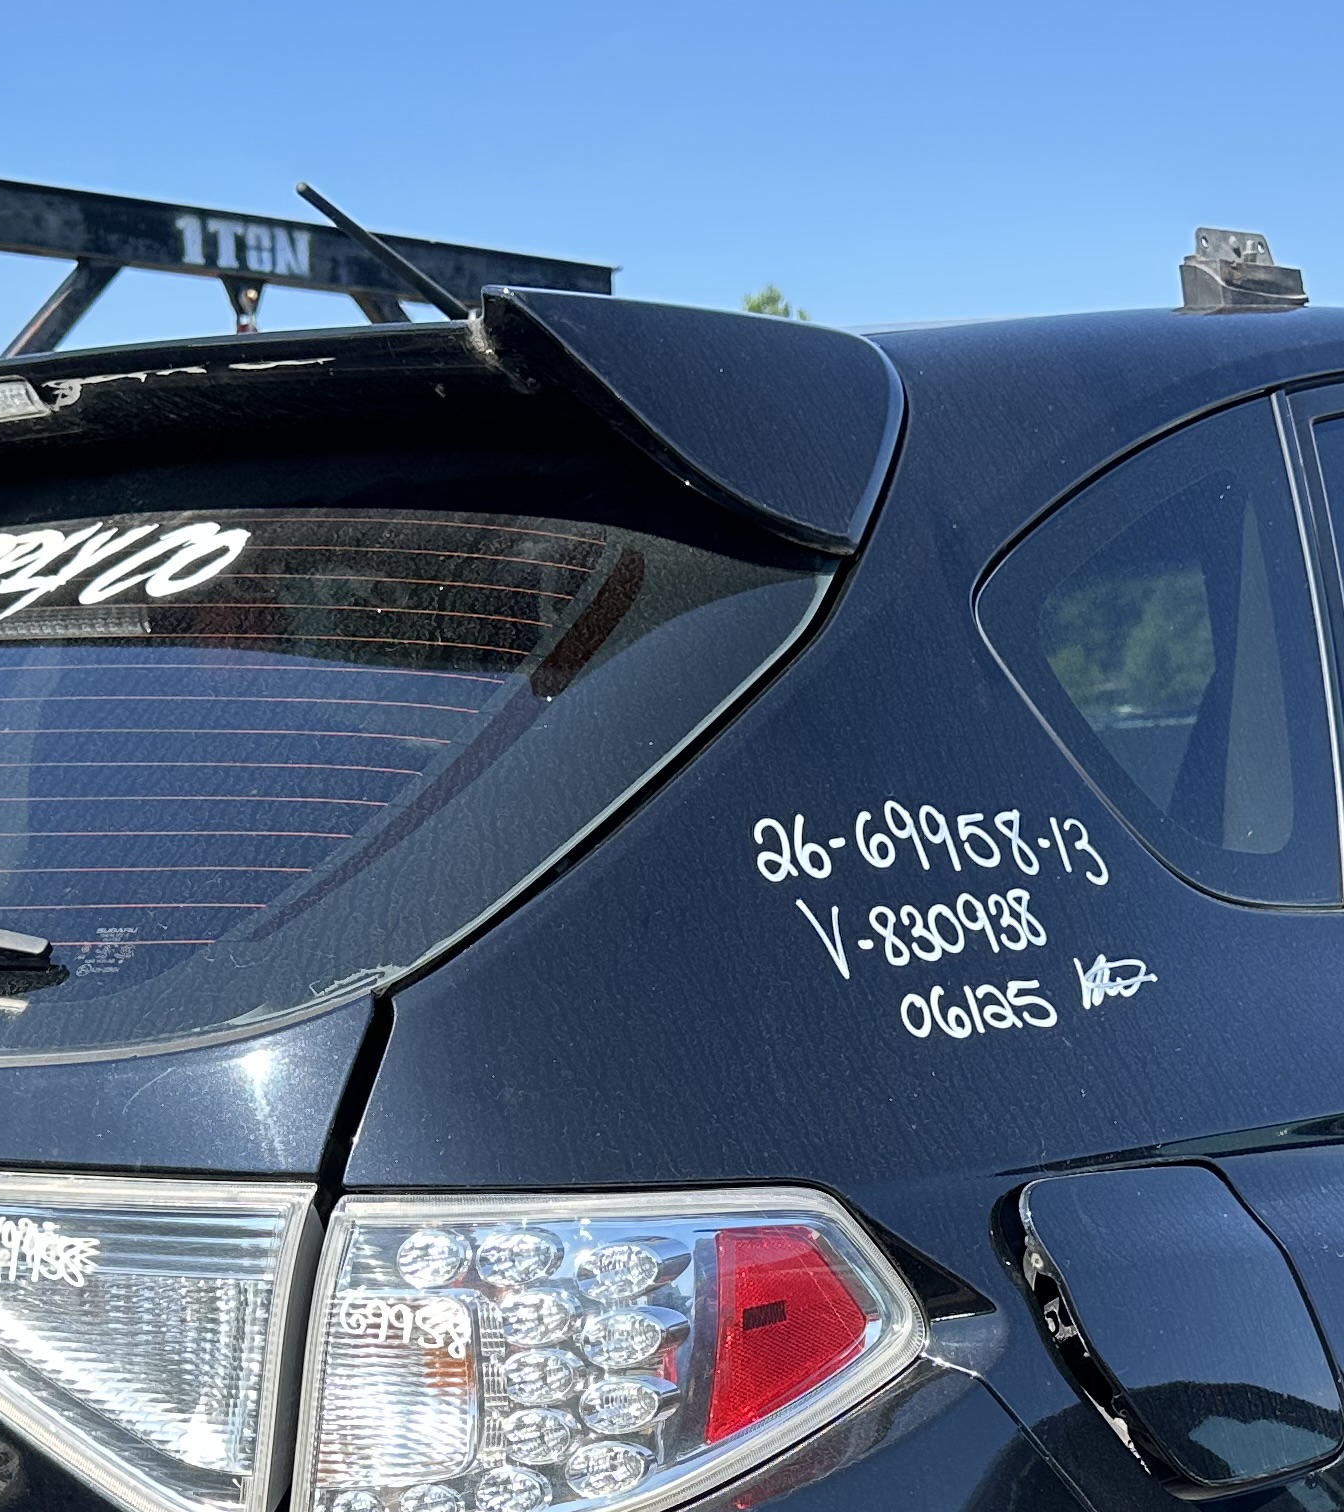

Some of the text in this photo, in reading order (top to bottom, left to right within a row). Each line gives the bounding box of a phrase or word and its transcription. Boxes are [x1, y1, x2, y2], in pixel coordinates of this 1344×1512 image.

[77, 521, 252, 605] CO
[753, 799, 1109, 886] 26-69958-13
[795, 887, 1048, 980] V-830938
[339, 1292, 472, 1359] 69958
